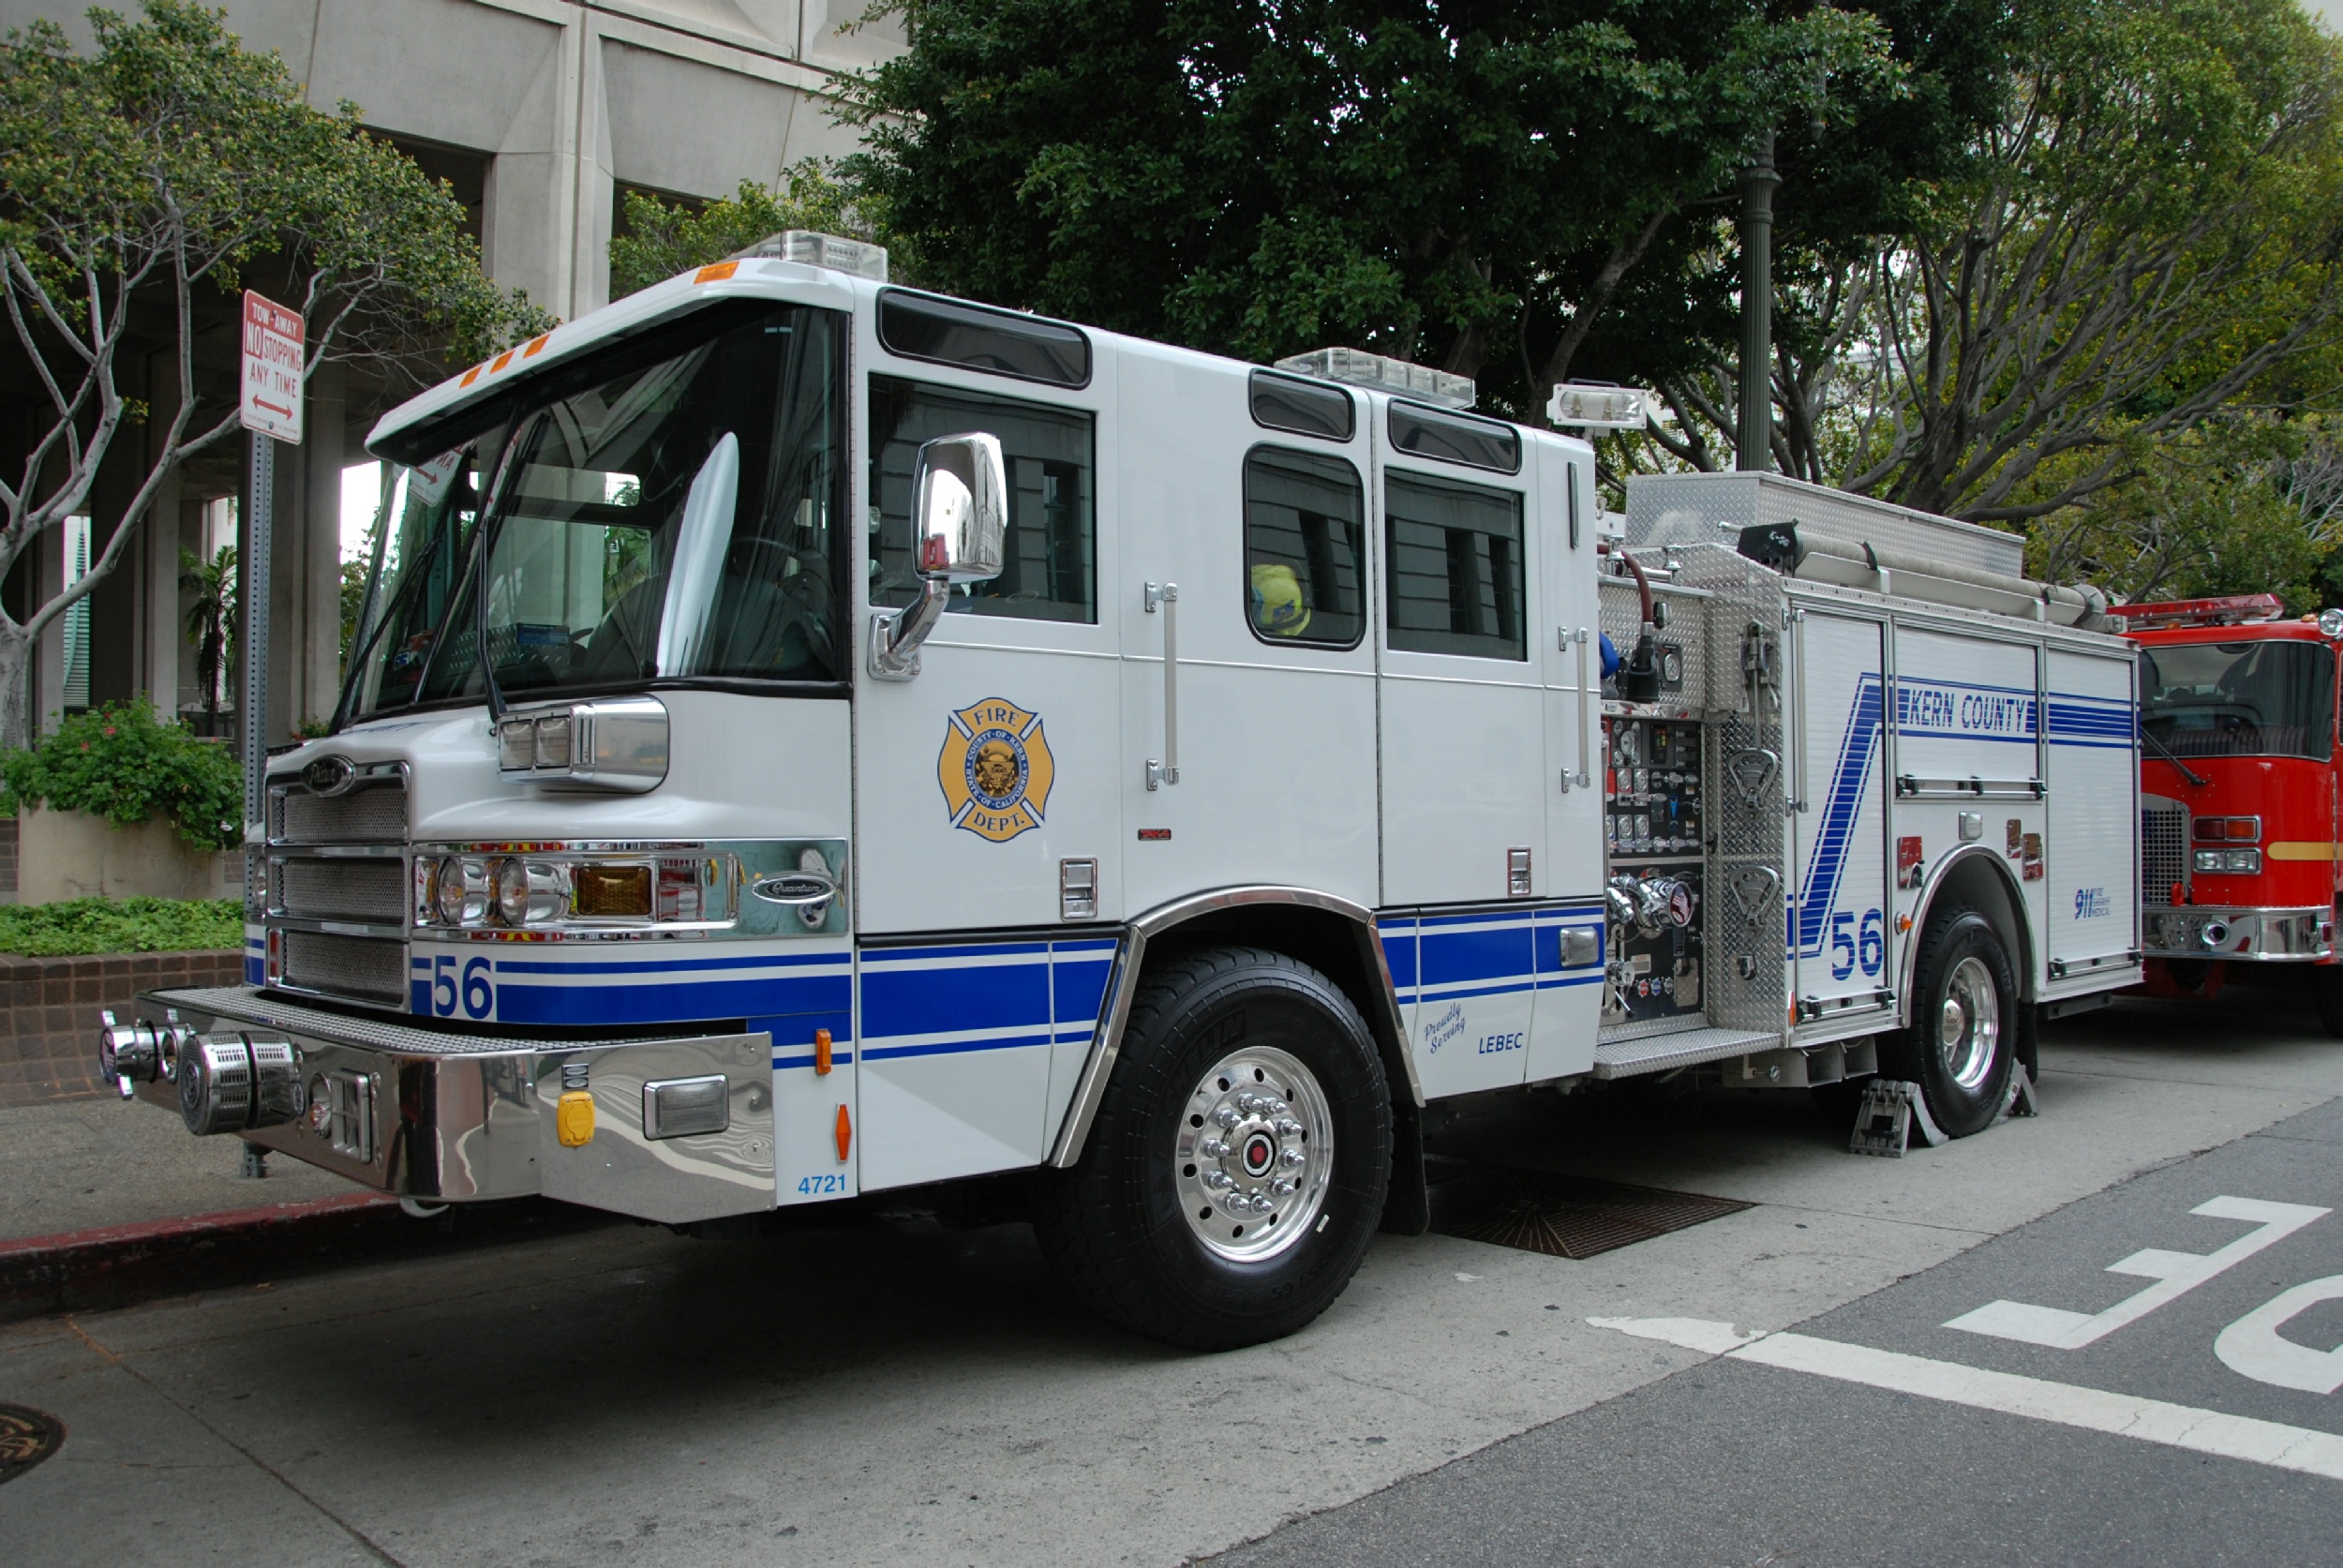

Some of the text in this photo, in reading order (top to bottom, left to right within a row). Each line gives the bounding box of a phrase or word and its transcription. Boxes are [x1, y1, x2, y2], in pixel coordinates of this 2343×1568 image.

[252, 302, 298, 337] TOW-AWAY
[246, 321, 302, 372] NO STOPPING
[249, 362, 297, 397] ANY TIME
[974, 708, 1020, 726] FIRE
[1910, 689, 2025, 732] KERN COUNTY
[967, 730, 1026, 760] COUNTY OF KERN
[965, 769, 1028, 808] STATE OF CALIFORNIA
[973, 812, 1024, 830] DEPT.
[772, 882, 820, 895] Quantum
[2074, 889, 2094, 919] 911
[1832, 908, 1884, 981] 56
[435, 955, 493, 1020] 56
[1425, 1002, 1461, 1041] Proudly
[1430, 1017, 1466, 1054] Serving
[1479, 1033, 1523, 1054] LEBEC
[798, 1173, 845, 1195] 4721
